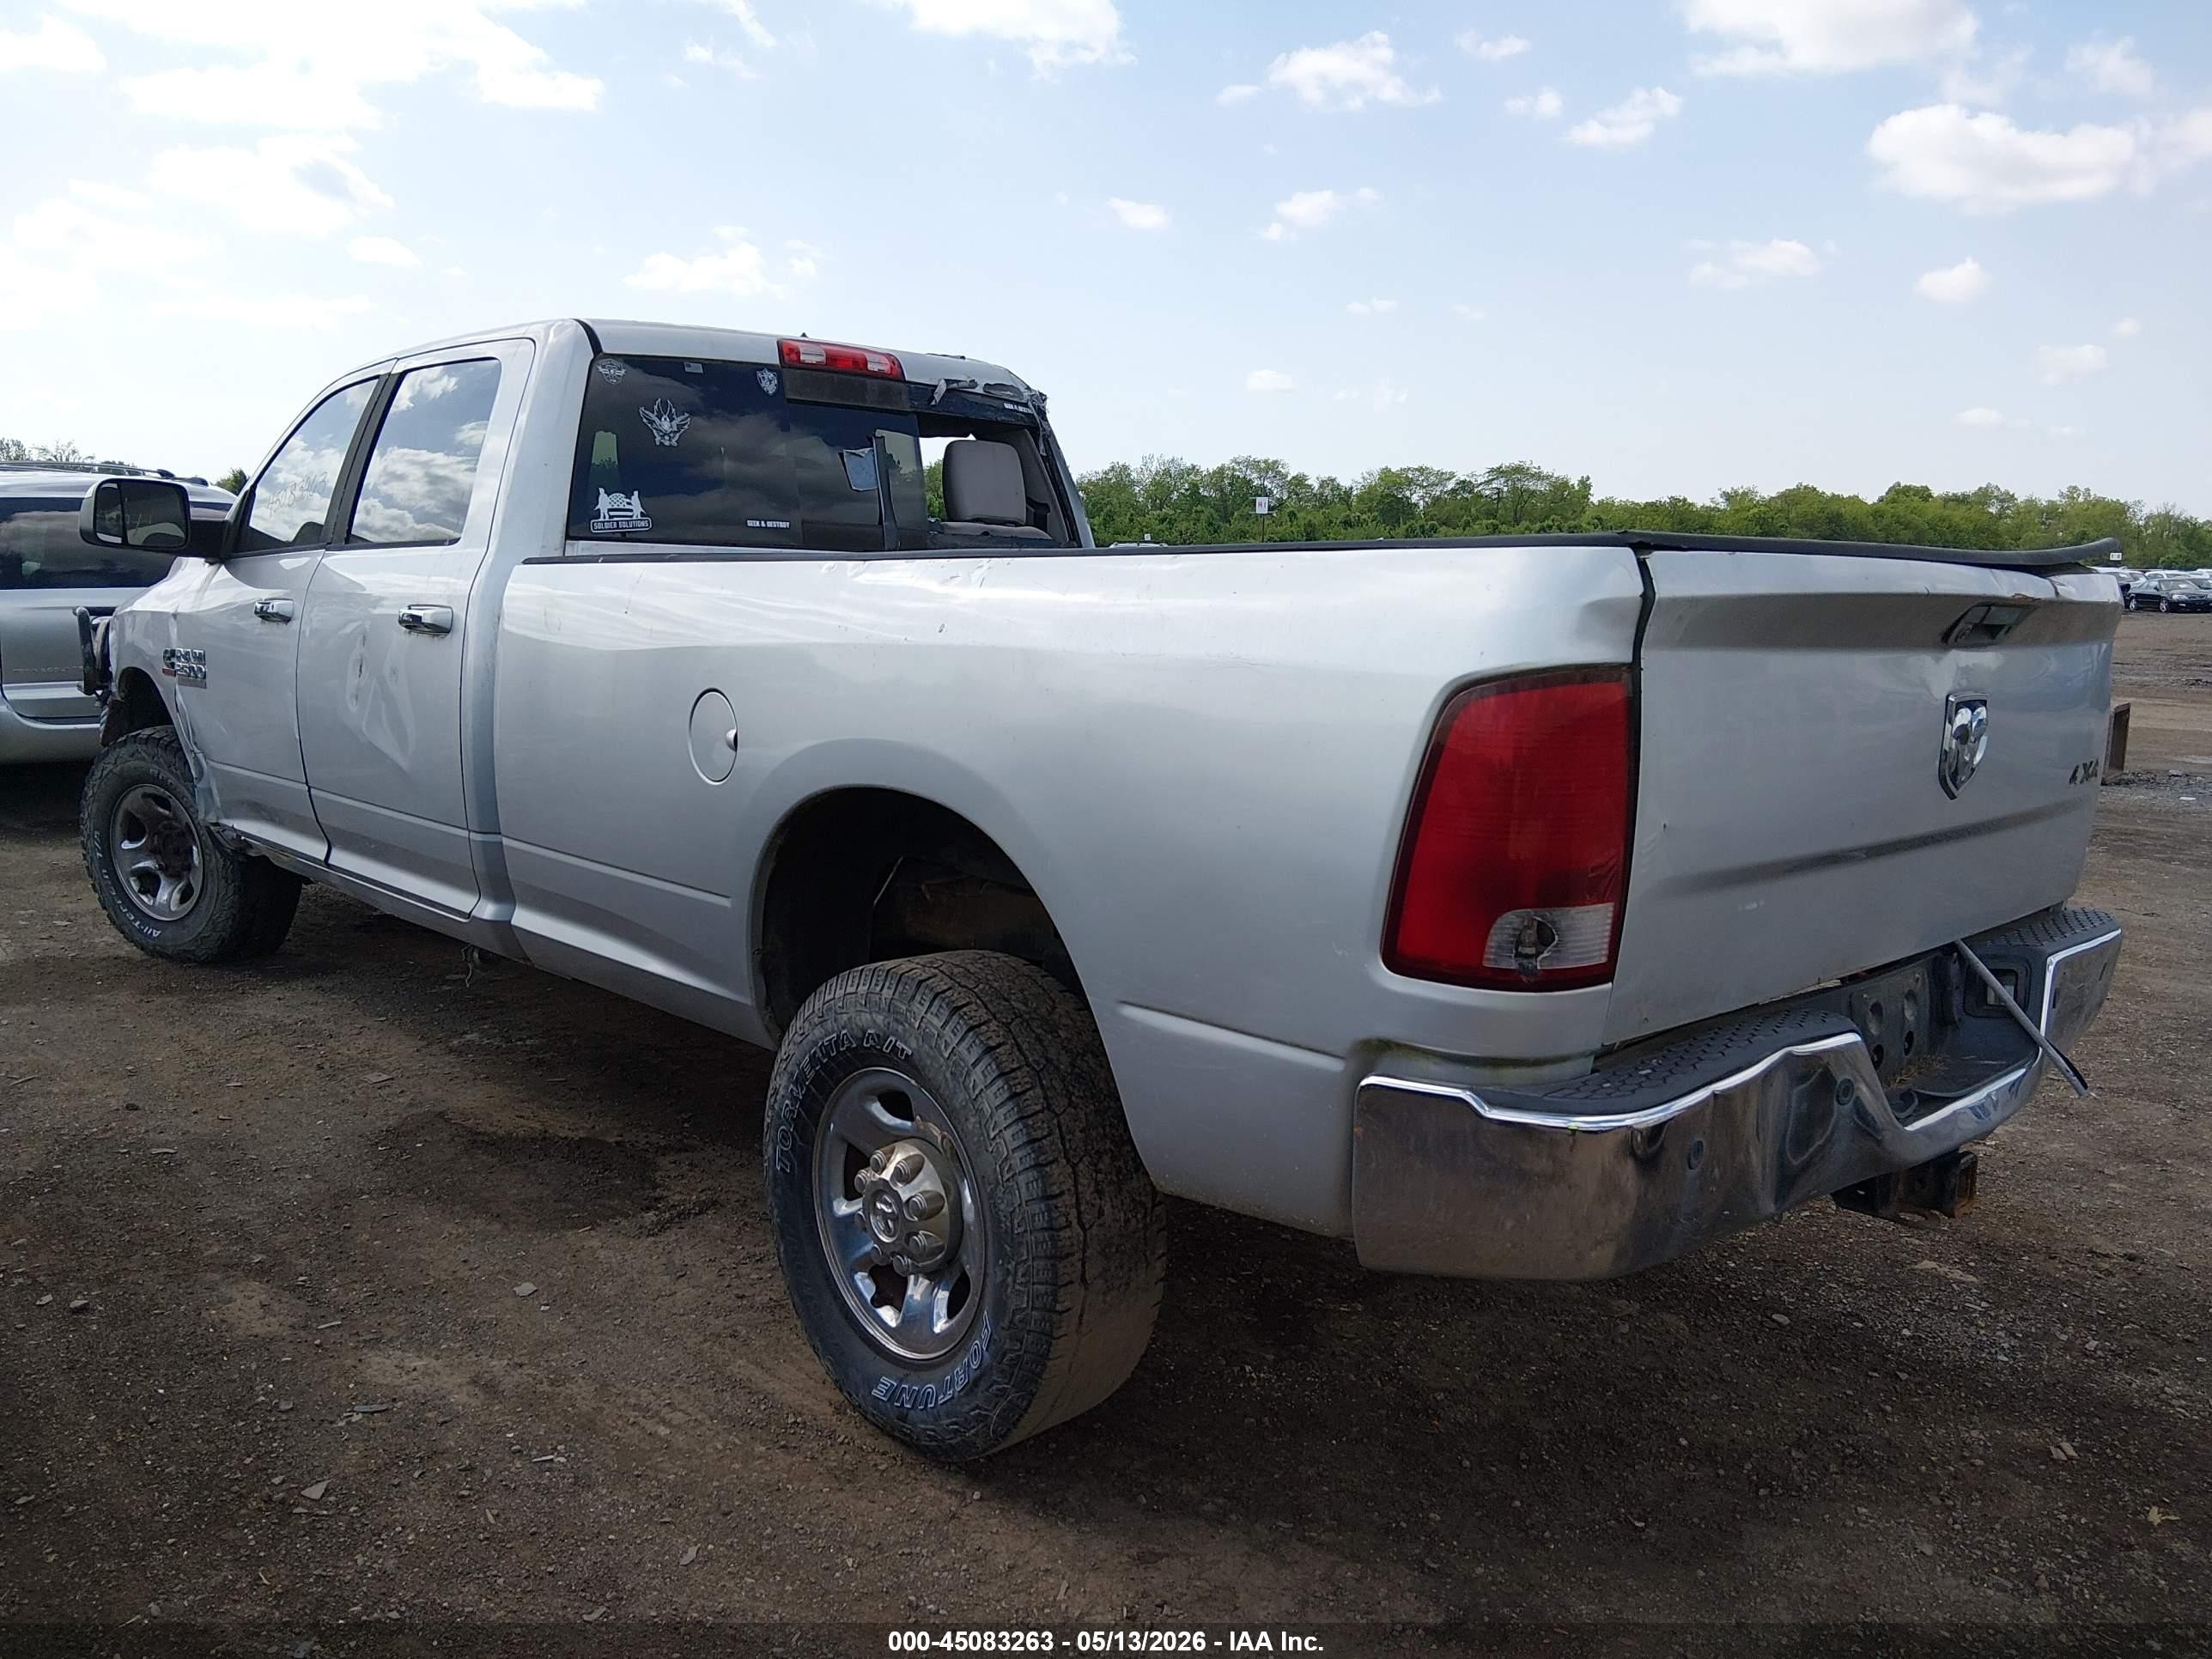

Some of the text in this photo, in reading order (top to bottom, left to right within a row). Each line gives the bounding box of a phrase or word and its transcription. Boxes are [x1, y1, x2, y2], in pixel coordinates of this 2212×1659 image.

[593, 520, 649, 530] SOLDIER SOLUTIONS
[175, 662, 207, 679] 2500
[872, 1310, 992, 1409] FORTUNE
